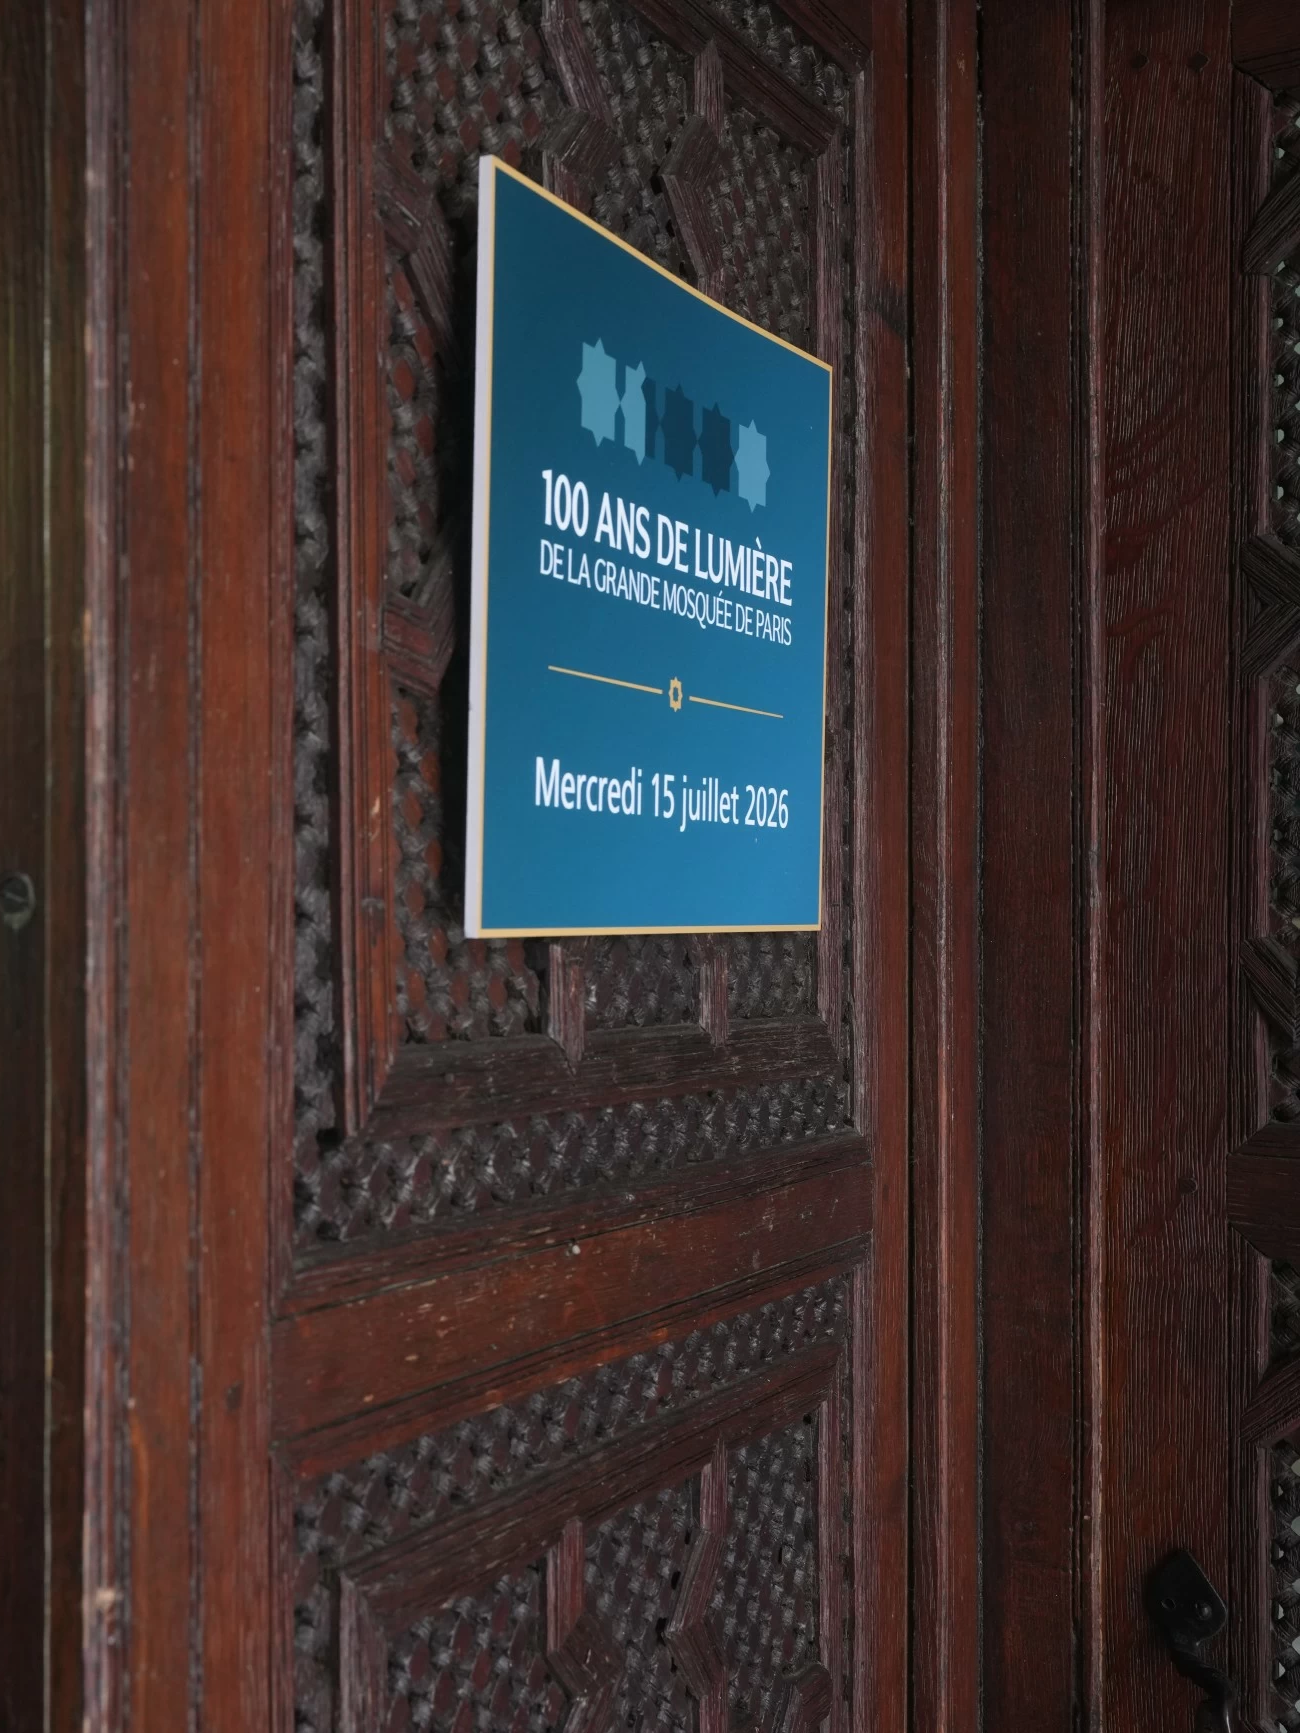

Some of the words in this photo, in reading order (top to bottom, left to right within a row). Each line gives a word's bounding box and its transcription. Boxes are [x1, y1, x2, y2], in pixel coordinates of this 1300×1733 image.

[542, 469, 589, 537] 100
[594, 492, 650, 559] ANS
[657, 513, 689, 573] DE
[695, 528, 792, 606] LUMIÈRE
[540, 539, 564, 580] DE
[568, 548, 591, 588] LA
[594, 559, 660, 609] GRANDE
[663, 580, 732, 629] MOSQUÉE
[735, 603, 753, 636] DE
[756, 609, 792, 646] PARIS
[535, 756, 642, 815] Mercredi
[652, 773, 675, 818] 15
[680, 775, 739, 832] juillet
[745, 785, 789, 829] 2026
